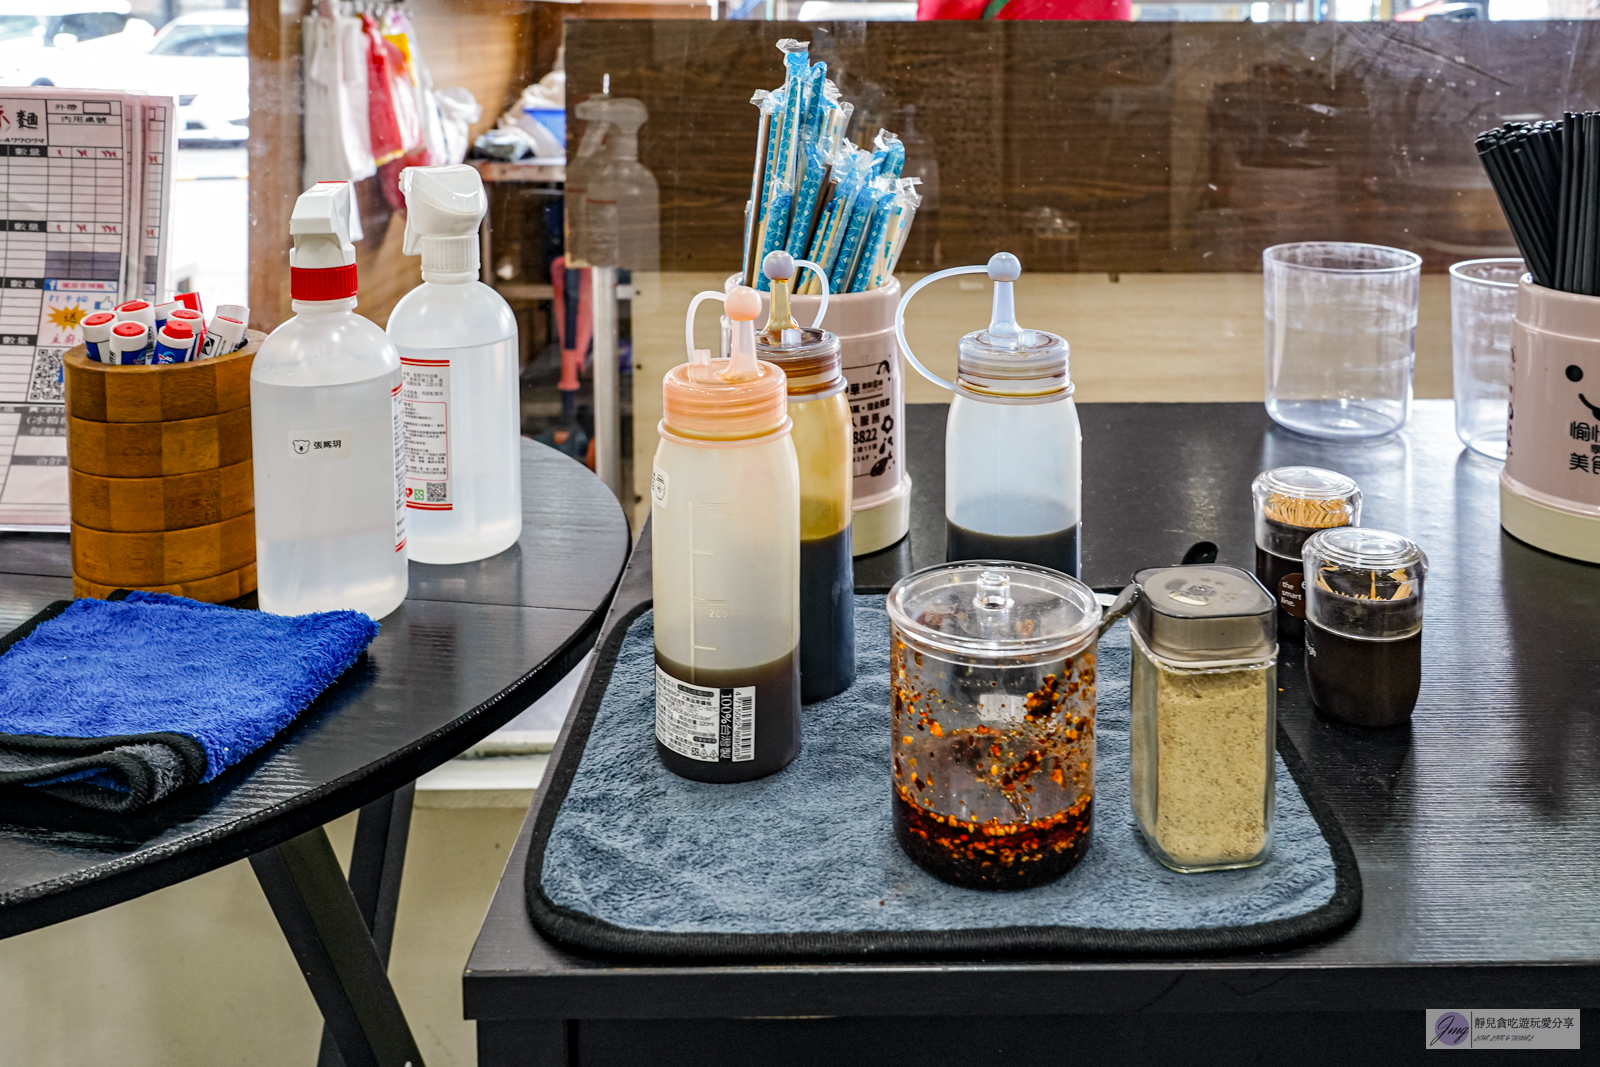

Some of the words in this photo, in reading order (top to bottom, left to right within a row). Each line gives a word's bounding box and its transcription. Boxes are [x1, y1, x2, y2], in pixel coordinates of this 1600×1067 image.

[1282, 581, 1295, 591] the
[1281, 590, 1302, 601] smart
[709, 608, 728, 619] 200
[720, 693, 732, 759] 100%台灣製
